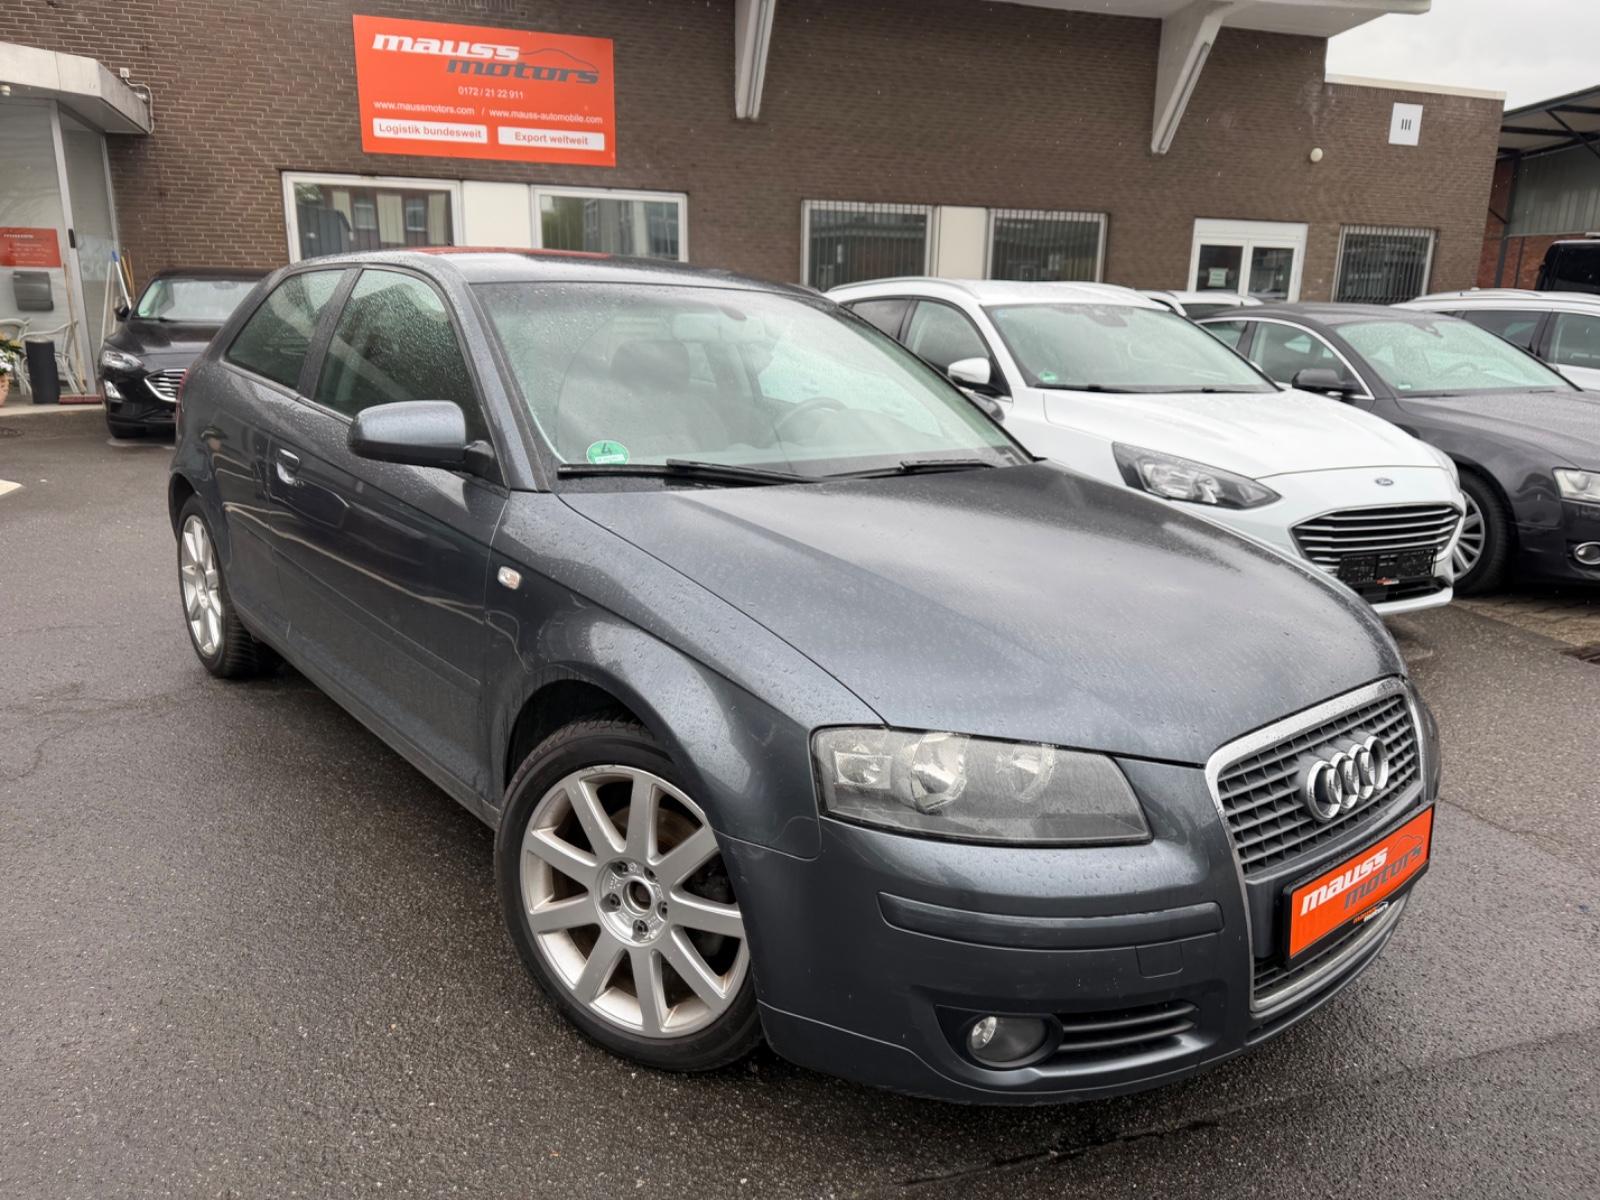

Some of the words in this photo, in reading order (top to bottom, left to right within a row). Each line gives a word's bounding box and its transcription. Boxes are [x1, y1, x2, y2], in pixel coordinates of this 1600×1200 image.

[372, 33, 520, 60] mauss
[447, 59, 599, 84] motors
[458, 86, 479, 97] 0172
[485, 88, 495, 97] 21
[497, 88, 508, 98] 22
[509, 90, 523, 99] 911
[373, 101, 475, 115] www.maussmotors.com
[489, 108, 603, 124] www.mauss-automobile.com
[379, 123, 421, 135] Logistik
[423, 126, 482, 138] bundesweit
[514, 131, 547, 143] Export
[549, 134, 588, 145] weltweit
[1300, 847, 1389, 917] mauss
[1343, 845, 1422, 910] motors
